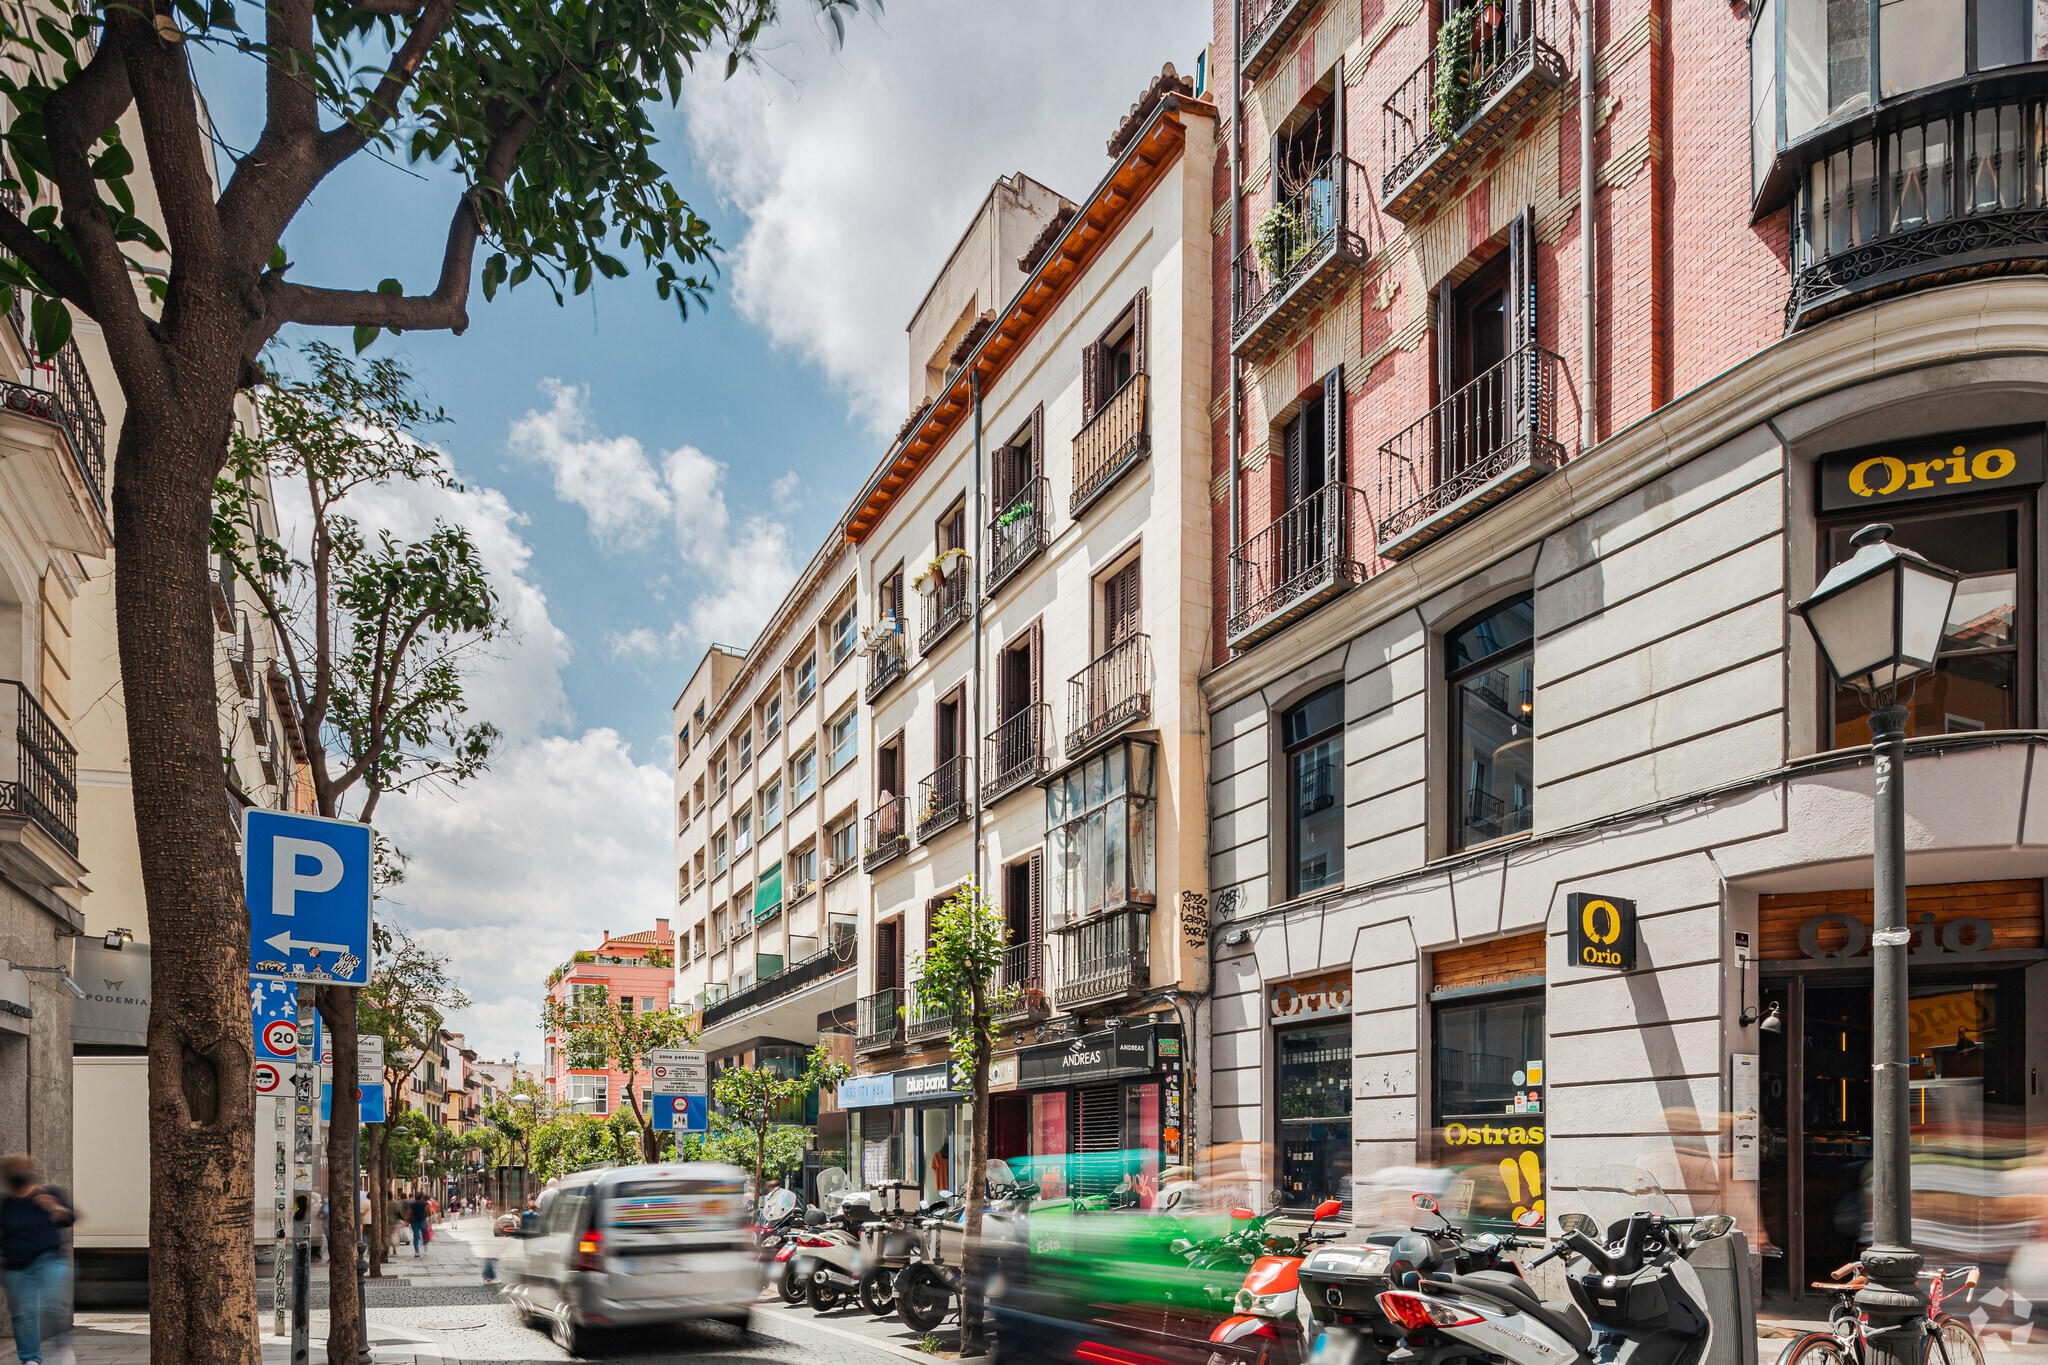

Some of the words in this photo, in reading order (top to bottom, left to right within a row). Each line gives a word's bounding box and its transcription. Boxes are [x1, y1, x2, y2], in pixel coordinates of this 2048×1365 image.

[1848, 446, 2016, 498] Orio
[271, 835, 344, 917] P
[1798, 912, 1994, 959] Oio
[1583, 946, 1622, 965] Orio
[86, 993, 148, 1006] PODEMIA
[1271, 981, 1352, 1017] Orio
[273, 1032, 294, 1044] 20
[1120, 1044, 1145, 1052] ANDREAS
[1062, 1050, 1101, 1068] ANDREAS
[906, 1076, 924, 1093] blue
[1444, 1122, 1545, 1146] Ostras
[1037, 1239, 1060, 1254] Eats
